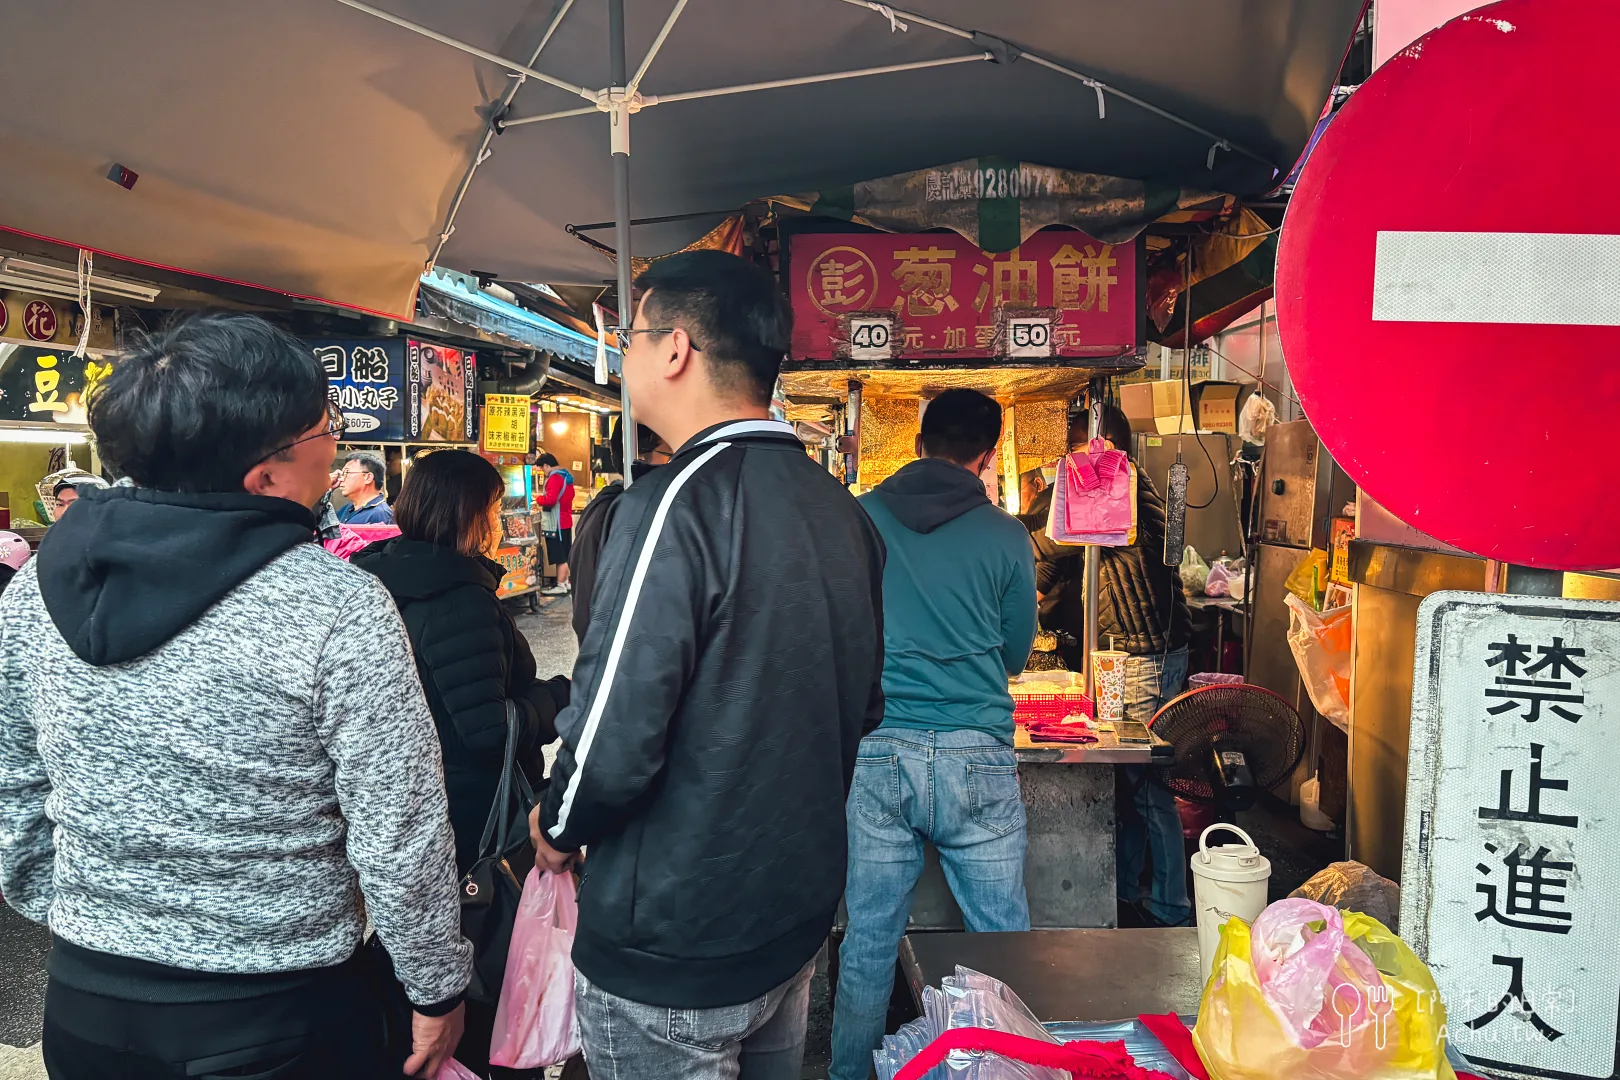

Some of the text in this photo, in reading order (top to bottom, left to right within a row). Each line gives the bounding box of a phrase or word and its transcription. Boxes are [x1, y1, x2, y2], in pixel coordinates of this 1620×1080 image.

[820, 258, 865, 306] 彭
[27, 303, 55, 336] 花
[852, 324, 889, 348] 40
[1013, 323, 1048, 347] 50
[1463, 633, 1587, 1044] 禁止進入
